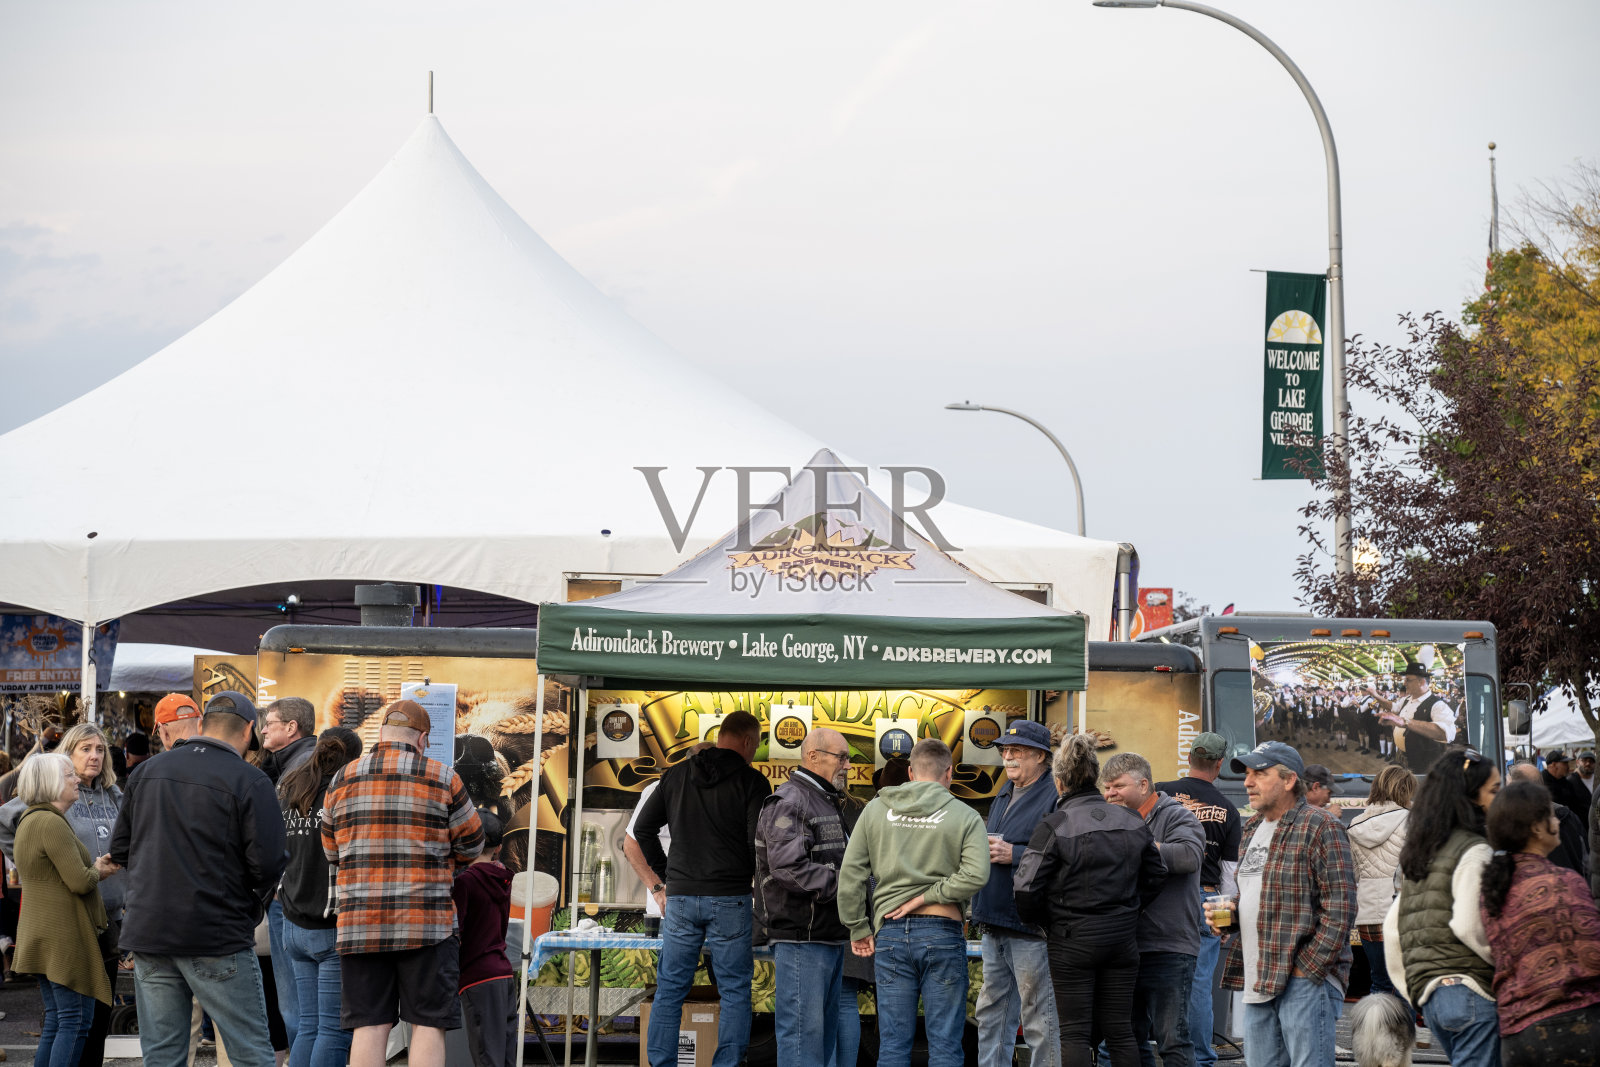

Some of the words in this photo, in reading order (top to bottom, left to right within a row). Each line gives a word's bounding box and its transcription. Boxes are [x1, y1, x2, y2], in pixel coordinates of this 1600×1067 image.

[1267, 349, 1320, 371] WELCOME
[1285, 373, 1300, 386] TO
[1278, 388, 1306, 409] LAKE
[1270, 412, 1314, 432] GEORGE
[743, 543, 901, 566] ADIRONDACK
[780, 556, 861, 570] BREWERY
[571, 627, 657, 654] Adirondack
[662, 630, 724, 661] Brewery
[742, 632, 778, 658] Lake
[782, 633, 839, 663] George,
[843, 635, 868, 660] NY
[882, 646, 1052, 664] ADKBREWERY.COM
[6, 670, 36, 681] FREE
